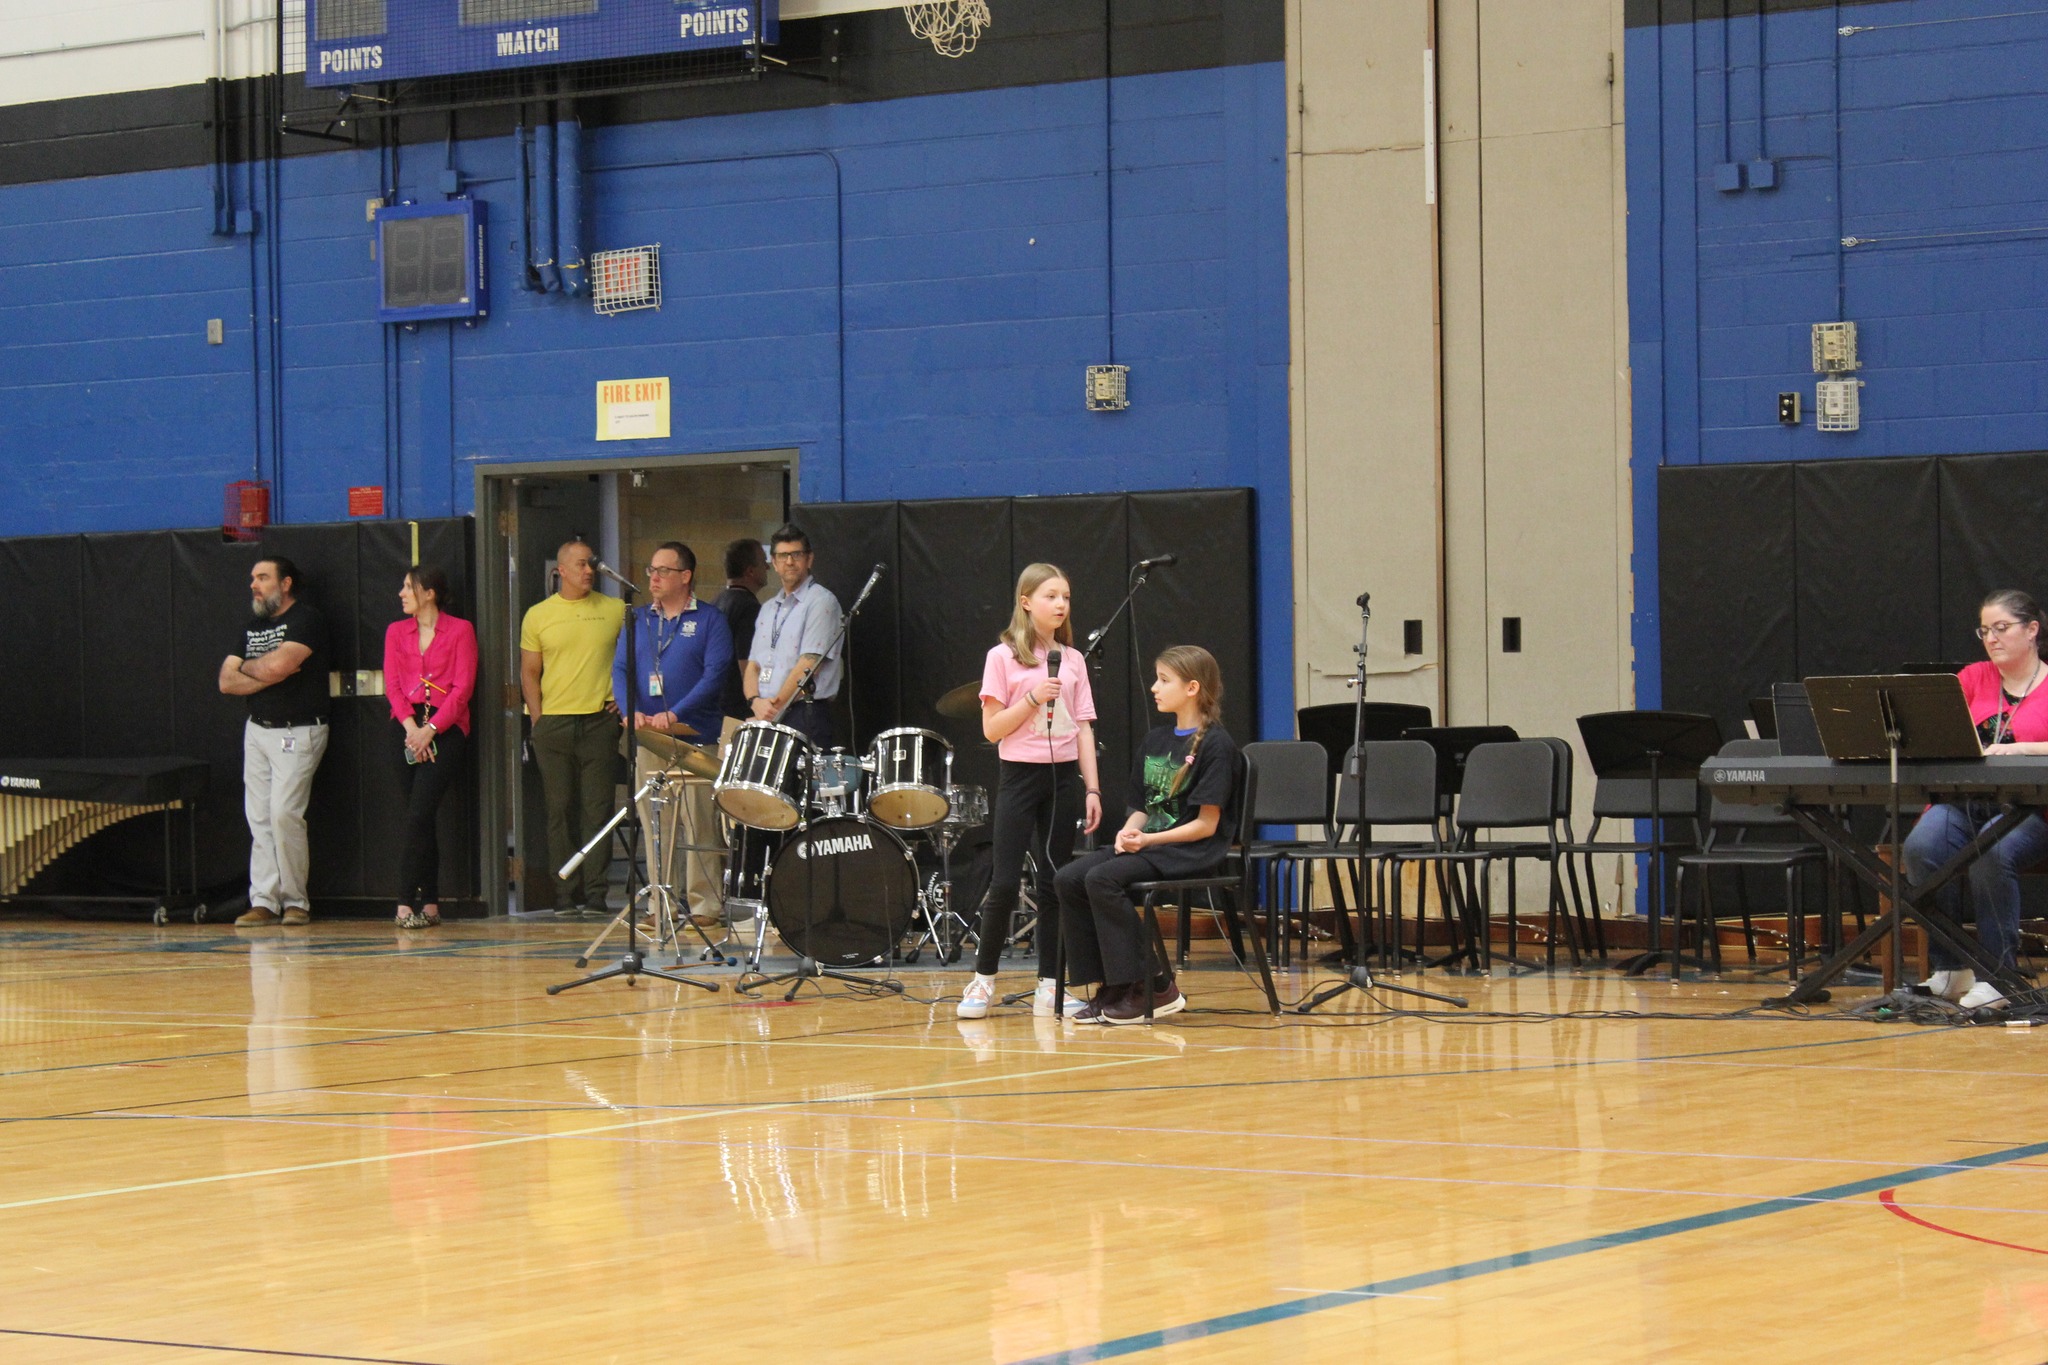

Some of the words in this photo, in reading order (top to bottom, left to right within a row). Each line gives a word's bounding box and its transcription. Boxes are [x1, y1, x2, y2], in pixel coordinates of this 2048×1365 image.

[681, 8, 748, 37] POINTS
[497, 27, 559, 57] MATCH
[320, 45, 383, 74] POINTS
[603, 384, 631, 404] FIRE
[635, 382, 662, 402] EXIT
[10, 776, 41, 789] YAMAHA
[1726, 769, 1766, 782] YAMAHA
[814, 834, 873, 856] YAMAHA
